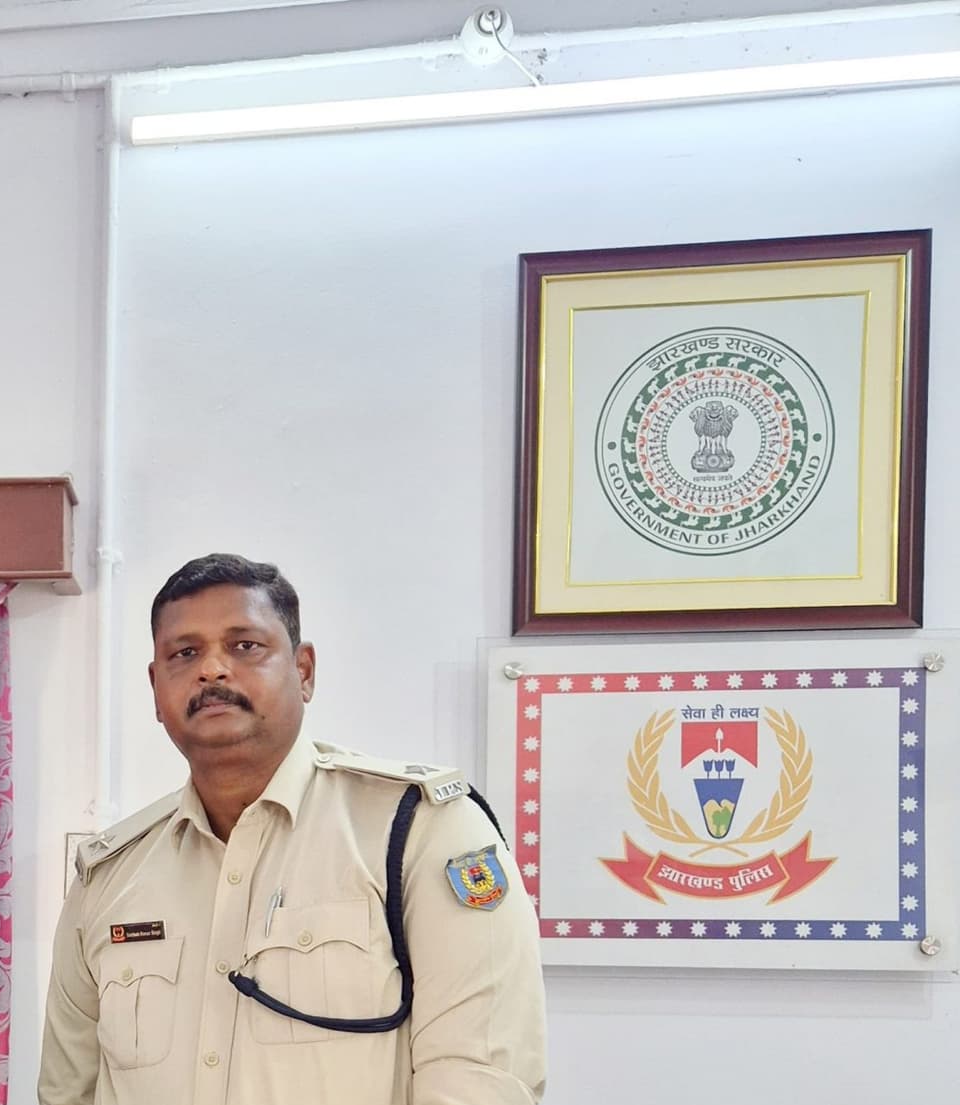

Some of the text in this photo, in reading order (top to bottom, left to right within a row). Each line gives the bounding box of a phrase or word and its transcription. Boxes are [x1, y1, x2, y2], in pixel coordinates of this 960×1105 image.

[646, 336, 786, 371] झारखण्ड सरकार
[608, 455, 821, 545] GOVERNMENT OF JHARKHAND
[681, 703, 760, 720] सेवा ही लक्ष्य
[657, 863, 774, 891] झारखण्ड पुलिस
